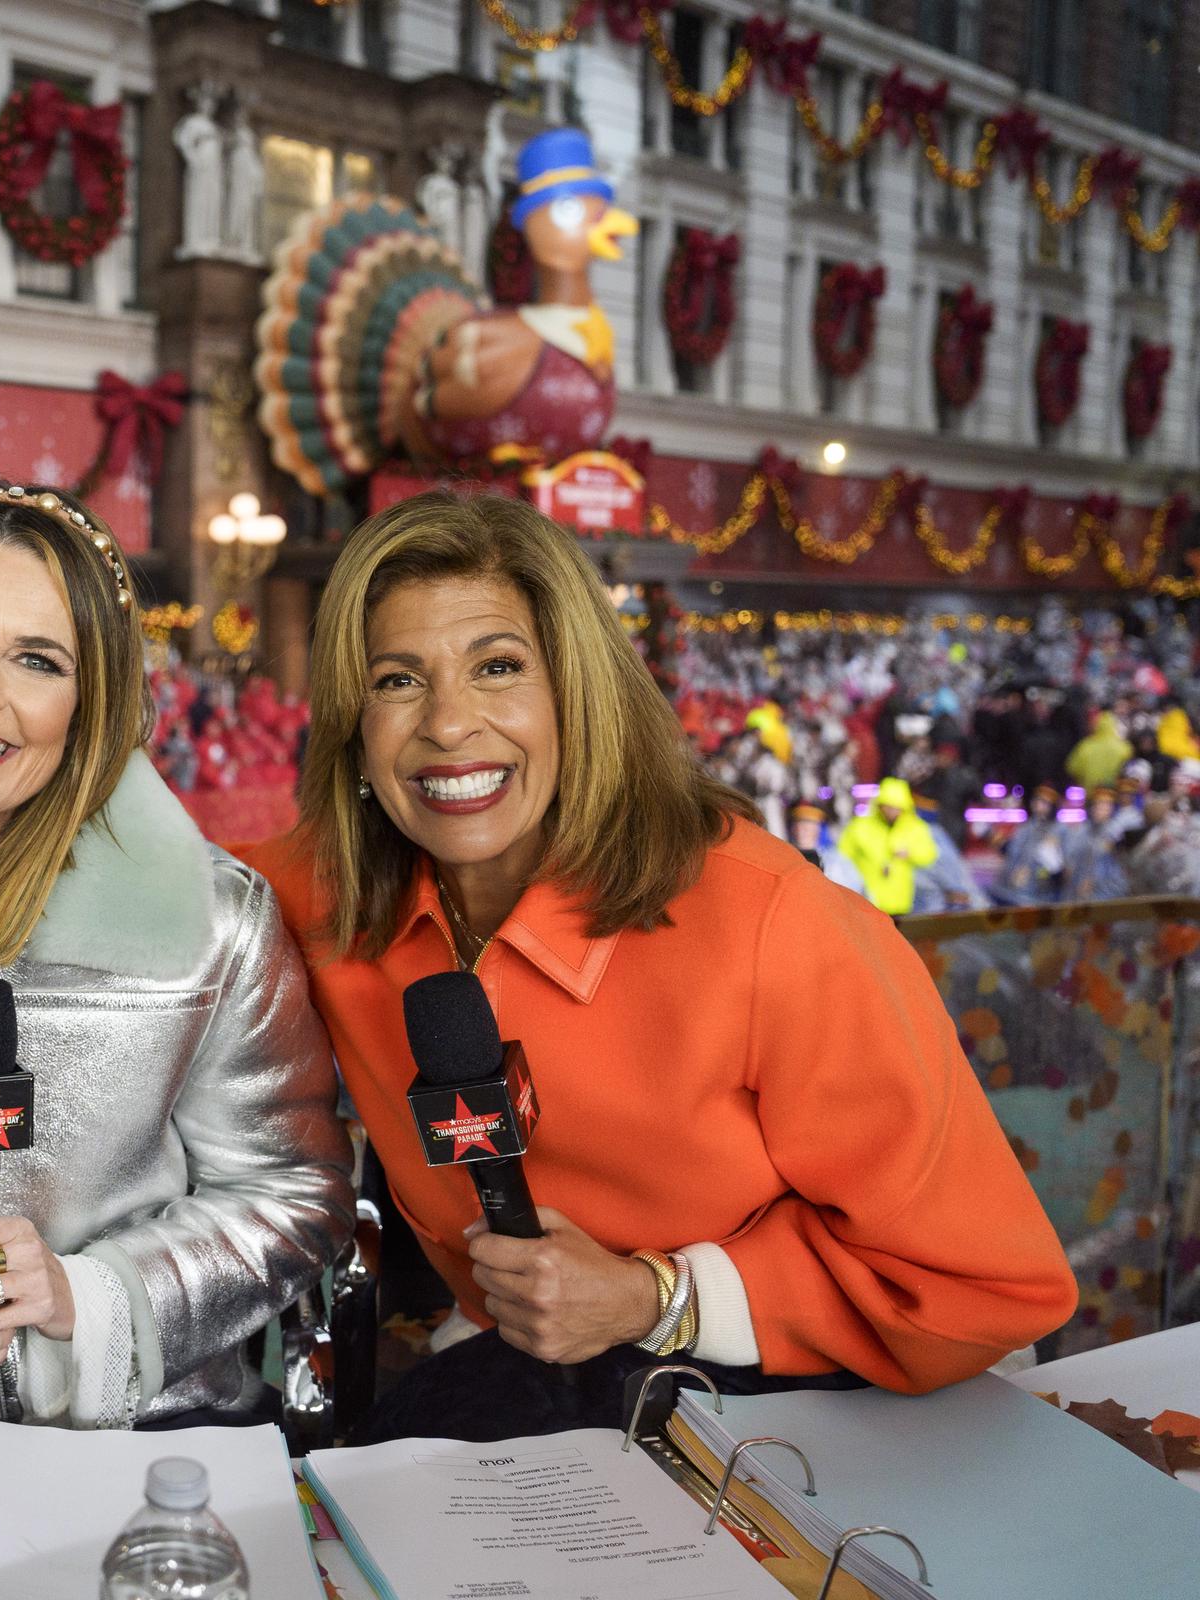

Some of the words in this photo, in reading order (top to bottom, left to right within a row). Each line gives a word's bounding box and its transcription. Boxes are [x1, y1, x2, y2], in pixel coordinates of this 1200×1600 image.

[7, 1115, 20, 1124] DAY
[436, 1124, 485, 1137] THANKSGIVING
[487, 1121, 500, 1130] DAY
[457, 1134, 484, 1143] PARADE
[478, 1457, 515, 1466] HOLD
